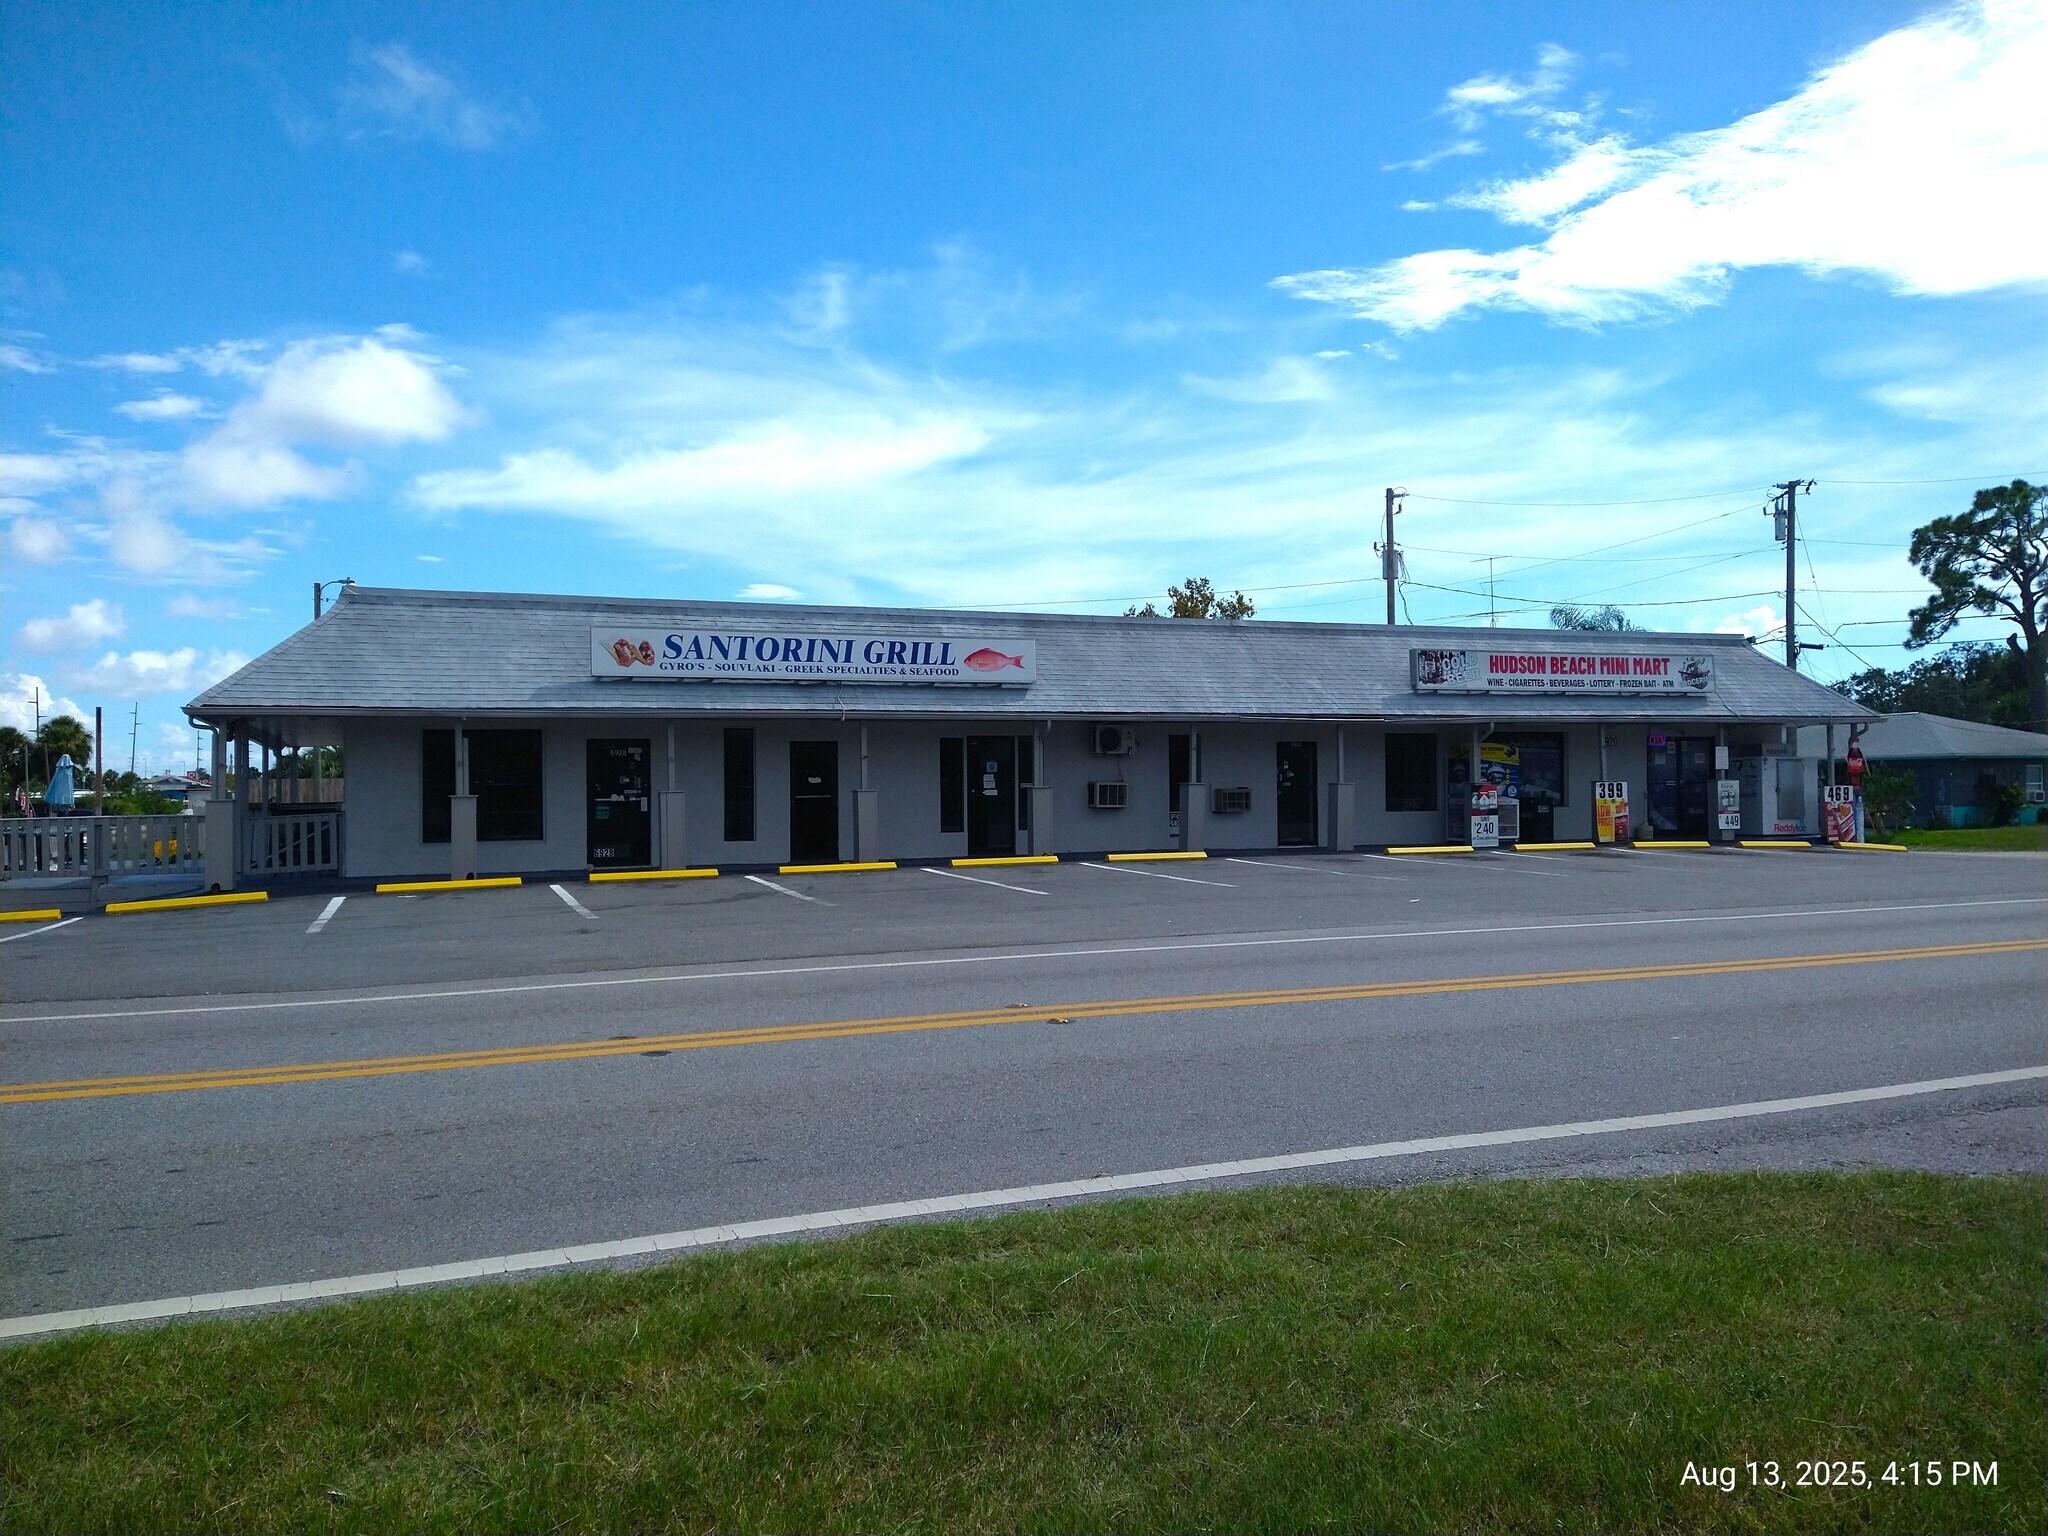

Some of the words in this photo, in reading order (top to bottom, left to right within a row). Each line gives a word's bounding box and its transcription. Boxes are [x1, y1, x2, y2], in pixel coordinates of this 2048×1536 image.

[662, 634, 856, 664] SANTORINI
[863, 640, 956, 666] GRILL
[659, 661, 705, 671] GYRO'S
[714, 663, 776, 673] SOUVLAKI
[785, 665, 823, 674] GREEK
[826, 666, 897, 675] SPECIALTIES
[899, 667, 907, 675] &
[909, 668, 960, 676] SEAFOOD
[1441, 651, 1479, 672] COLD
[1489, 655, 1546, 674] HUDSON
[1550, 656, 1596, 675] BEACH
[1599, 657, 1630, 675] MINI
[1633, 658, 1670, 676] MART
[1446, 667, 1482, 687] BEER
[1487, 678, 1504, 687] WINE
[1508, 678, 1546, 687] CIGARETTES
[1549, 679, 1585, 688] BEVERAGES
[1590, 679, 1615, 688] LOTTERY
[1620, 680, 1643, 688] FROZEN
[1644, 680, 1657, 688] BAIT
[1662, 680, 1675, 688] ATM
[610, 748, 627, 757] 6928
[1598, 782, 1623, 799] 399
[1828, 786, 1850, 802] 469
[594, 848, 614, 858] 6928
